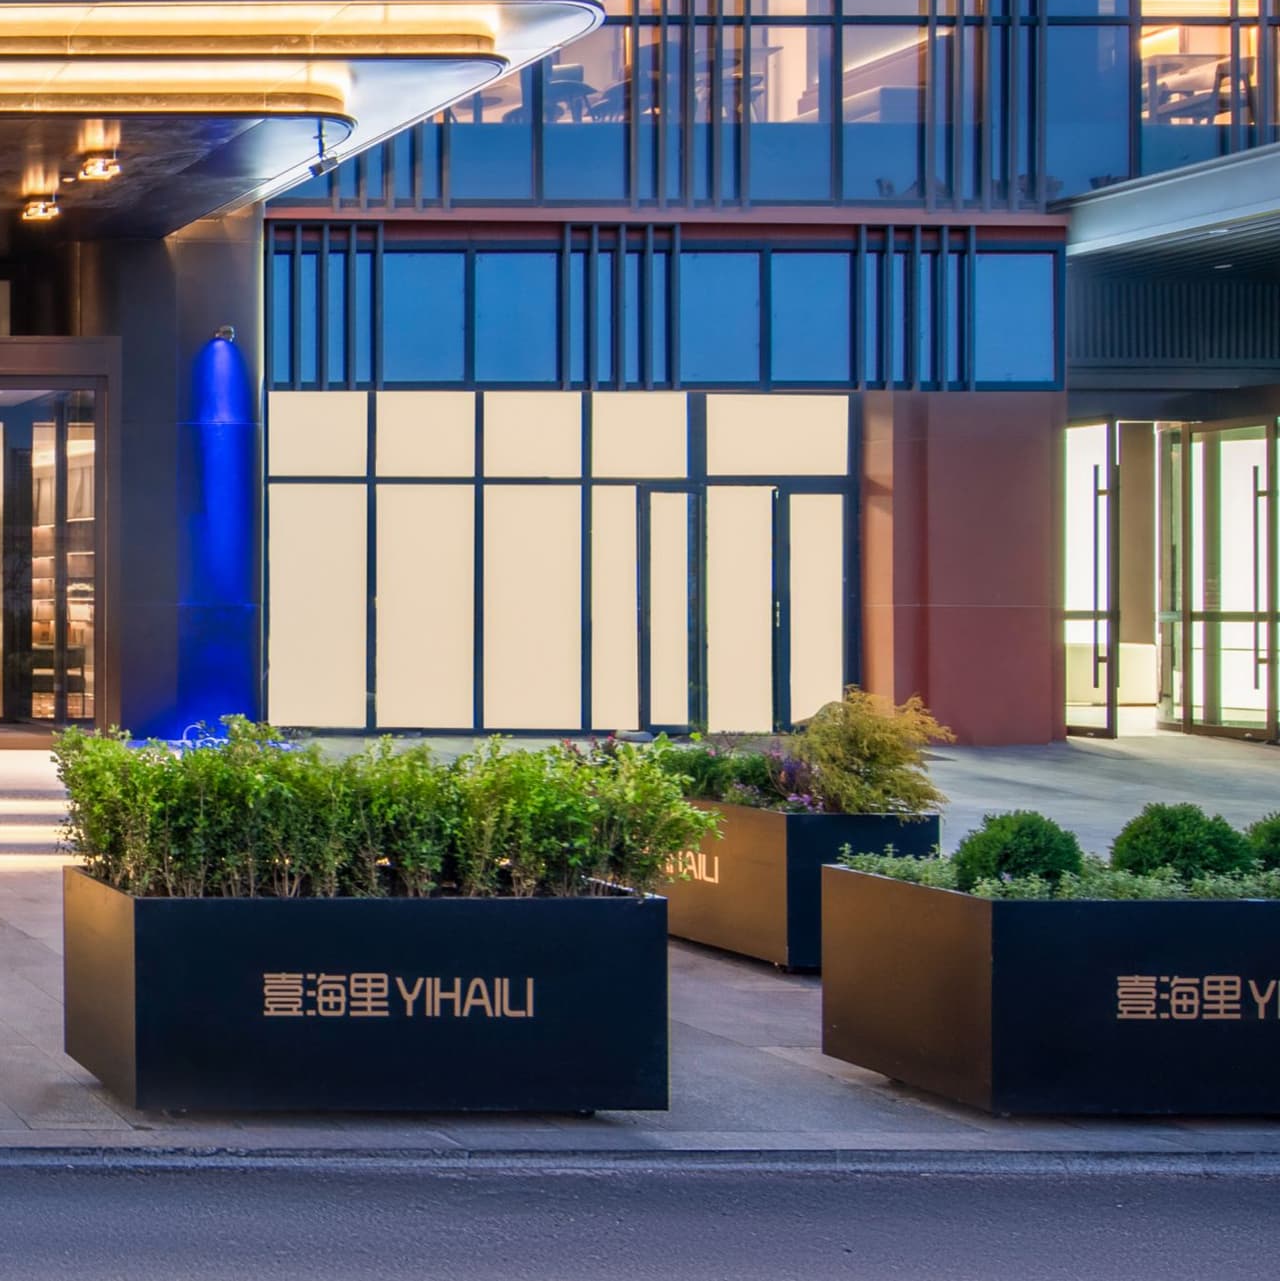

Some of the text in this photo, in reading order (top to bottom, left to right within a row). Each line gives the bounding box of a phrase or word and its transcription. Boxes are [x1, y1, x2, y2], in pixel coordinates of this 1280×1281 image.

[263, 973, 534, 1017] 壹海里 YIHAILI
[1116, 975, 1241, 1020] 壹海里
